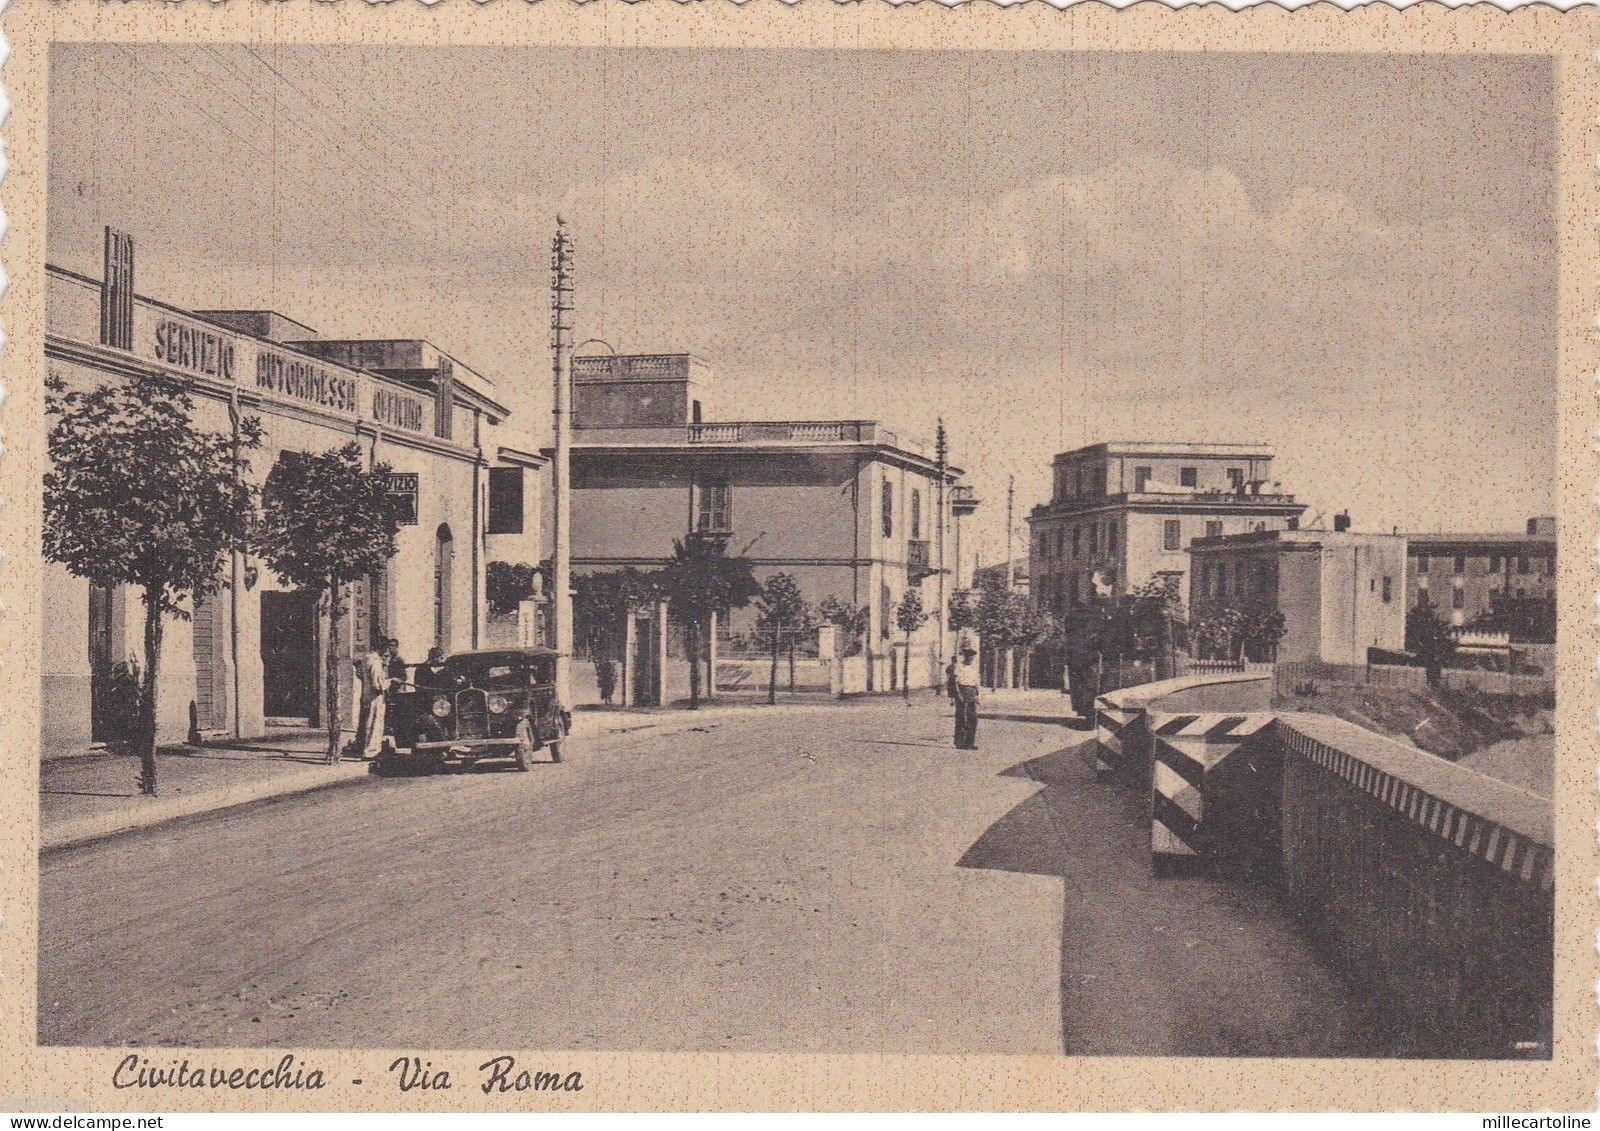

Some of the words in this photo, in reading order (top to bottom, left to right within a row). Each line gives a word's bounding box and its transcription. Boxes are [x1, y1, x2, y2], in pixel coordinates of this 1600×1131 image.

[155, 321, 234, 379] SERVIZIO
[256, 352, 356, 413] AUTORIMESSA
[387, 477, 416, 491] VIZIO
